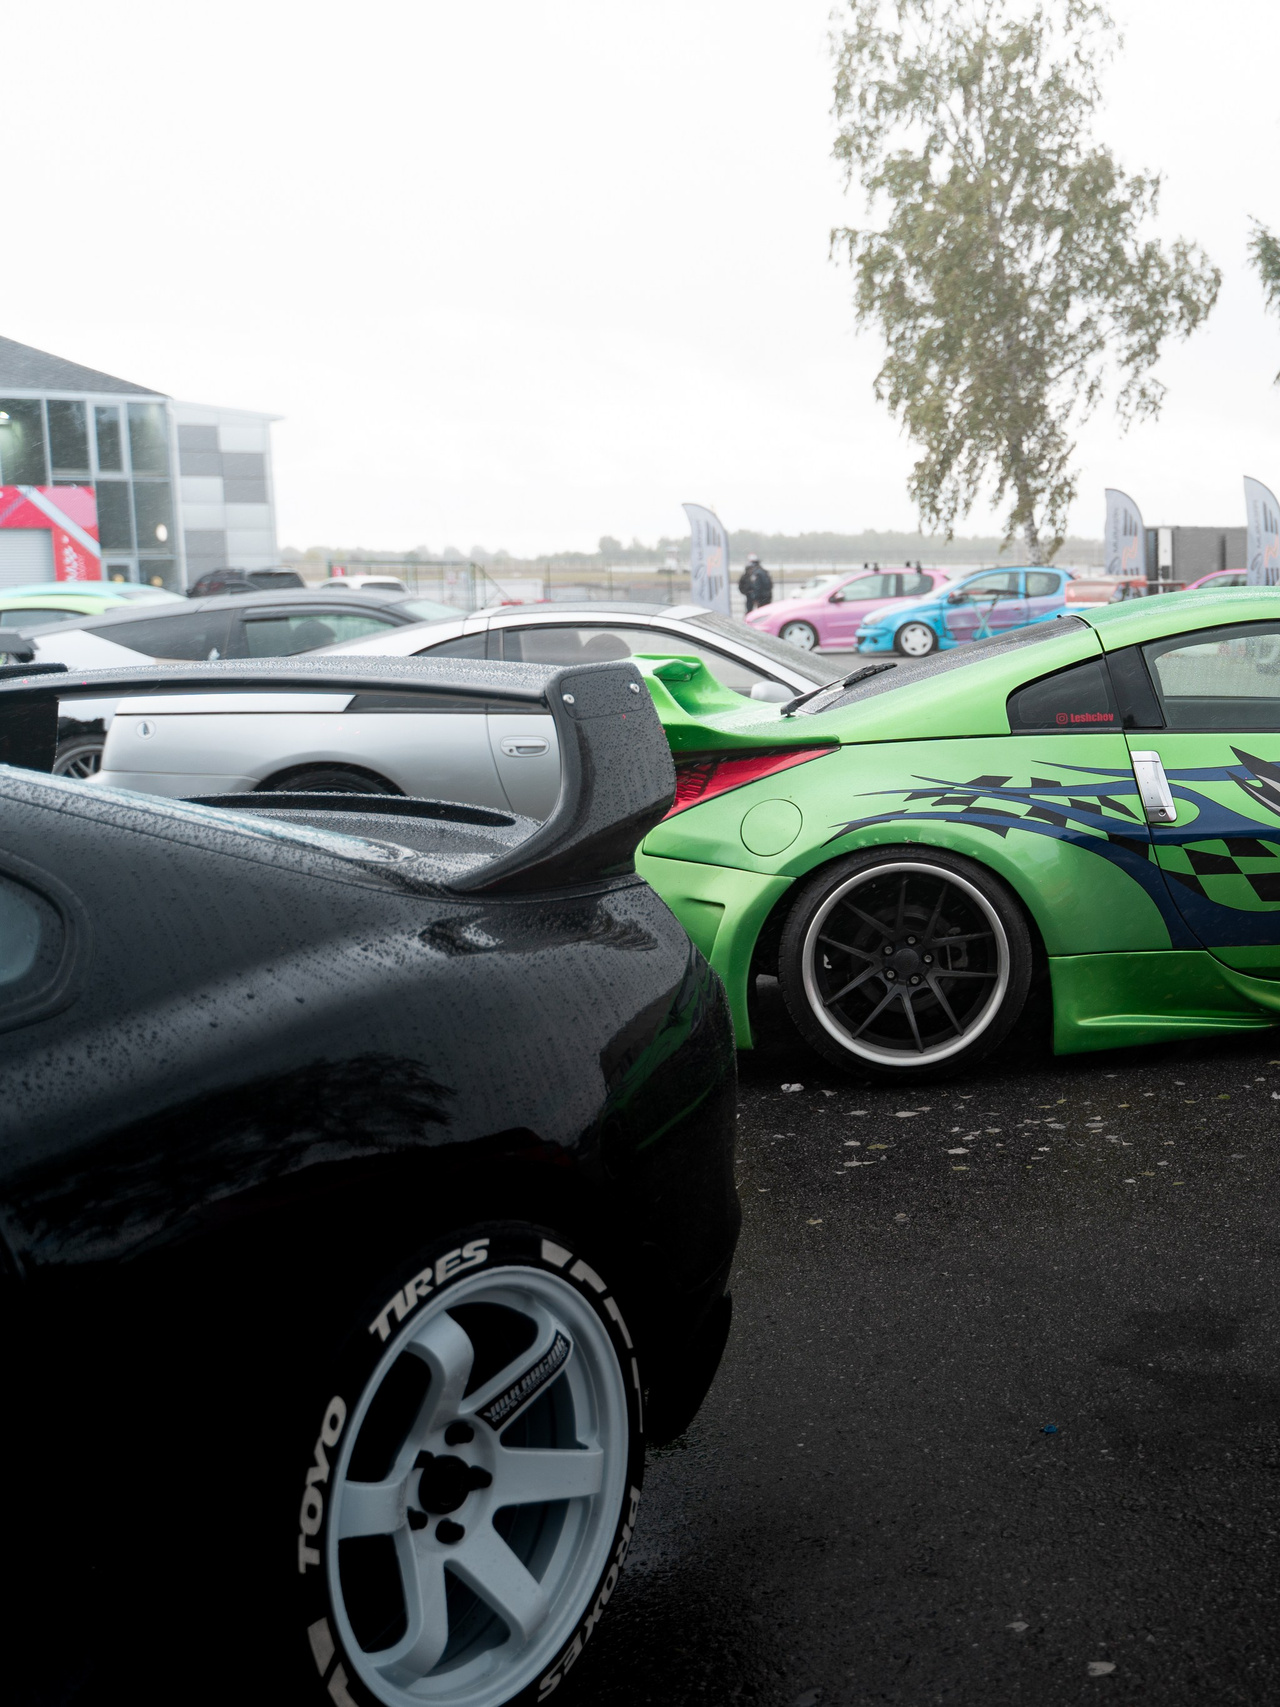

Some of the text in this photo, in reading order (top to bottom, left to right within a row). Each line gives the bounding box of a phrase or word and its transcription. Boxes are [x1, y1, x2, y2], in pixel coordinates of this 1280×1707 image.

[1070, 712, 1114, 723] Leshchov
[297, 1237, 491, 1575] TOYO TIRES
[491, 1398, 519, 1423] RAYS
[536, 1484, 641, 1704] PROXES
